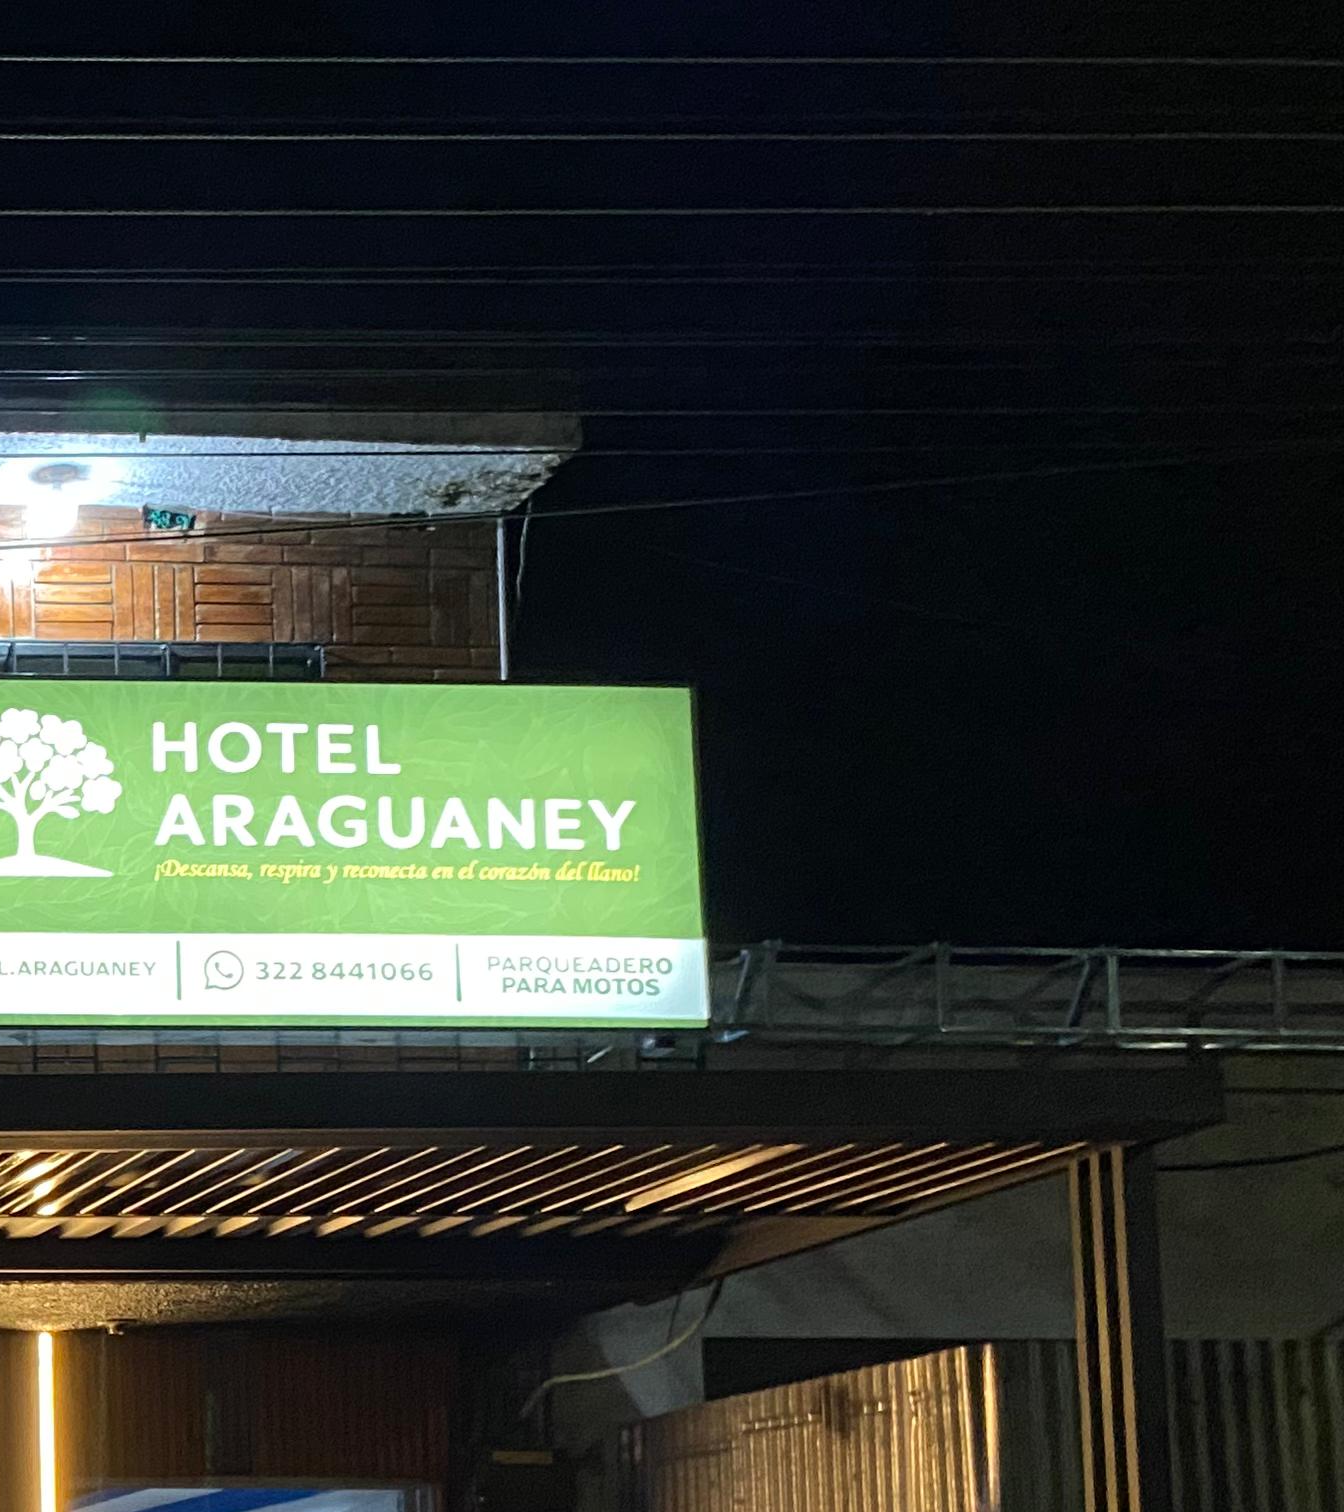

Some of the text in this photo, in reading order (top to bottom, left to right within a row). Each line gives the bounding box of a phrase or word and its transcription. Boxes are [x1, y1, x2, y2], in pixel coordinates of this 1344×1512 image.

[152, 722, 402, 775] HOTEL
[154, 794, 637, 851] ARAGUANEY
[154, 858, 641, 884] ¡Descansa, respira y reconecta en el corazón del llano!
[255, 961, 434, 982] 322 8441066
[487, 955, 673, 975] PARQUEADERO
[501, 976, 662, 997] PARA MOTOS
